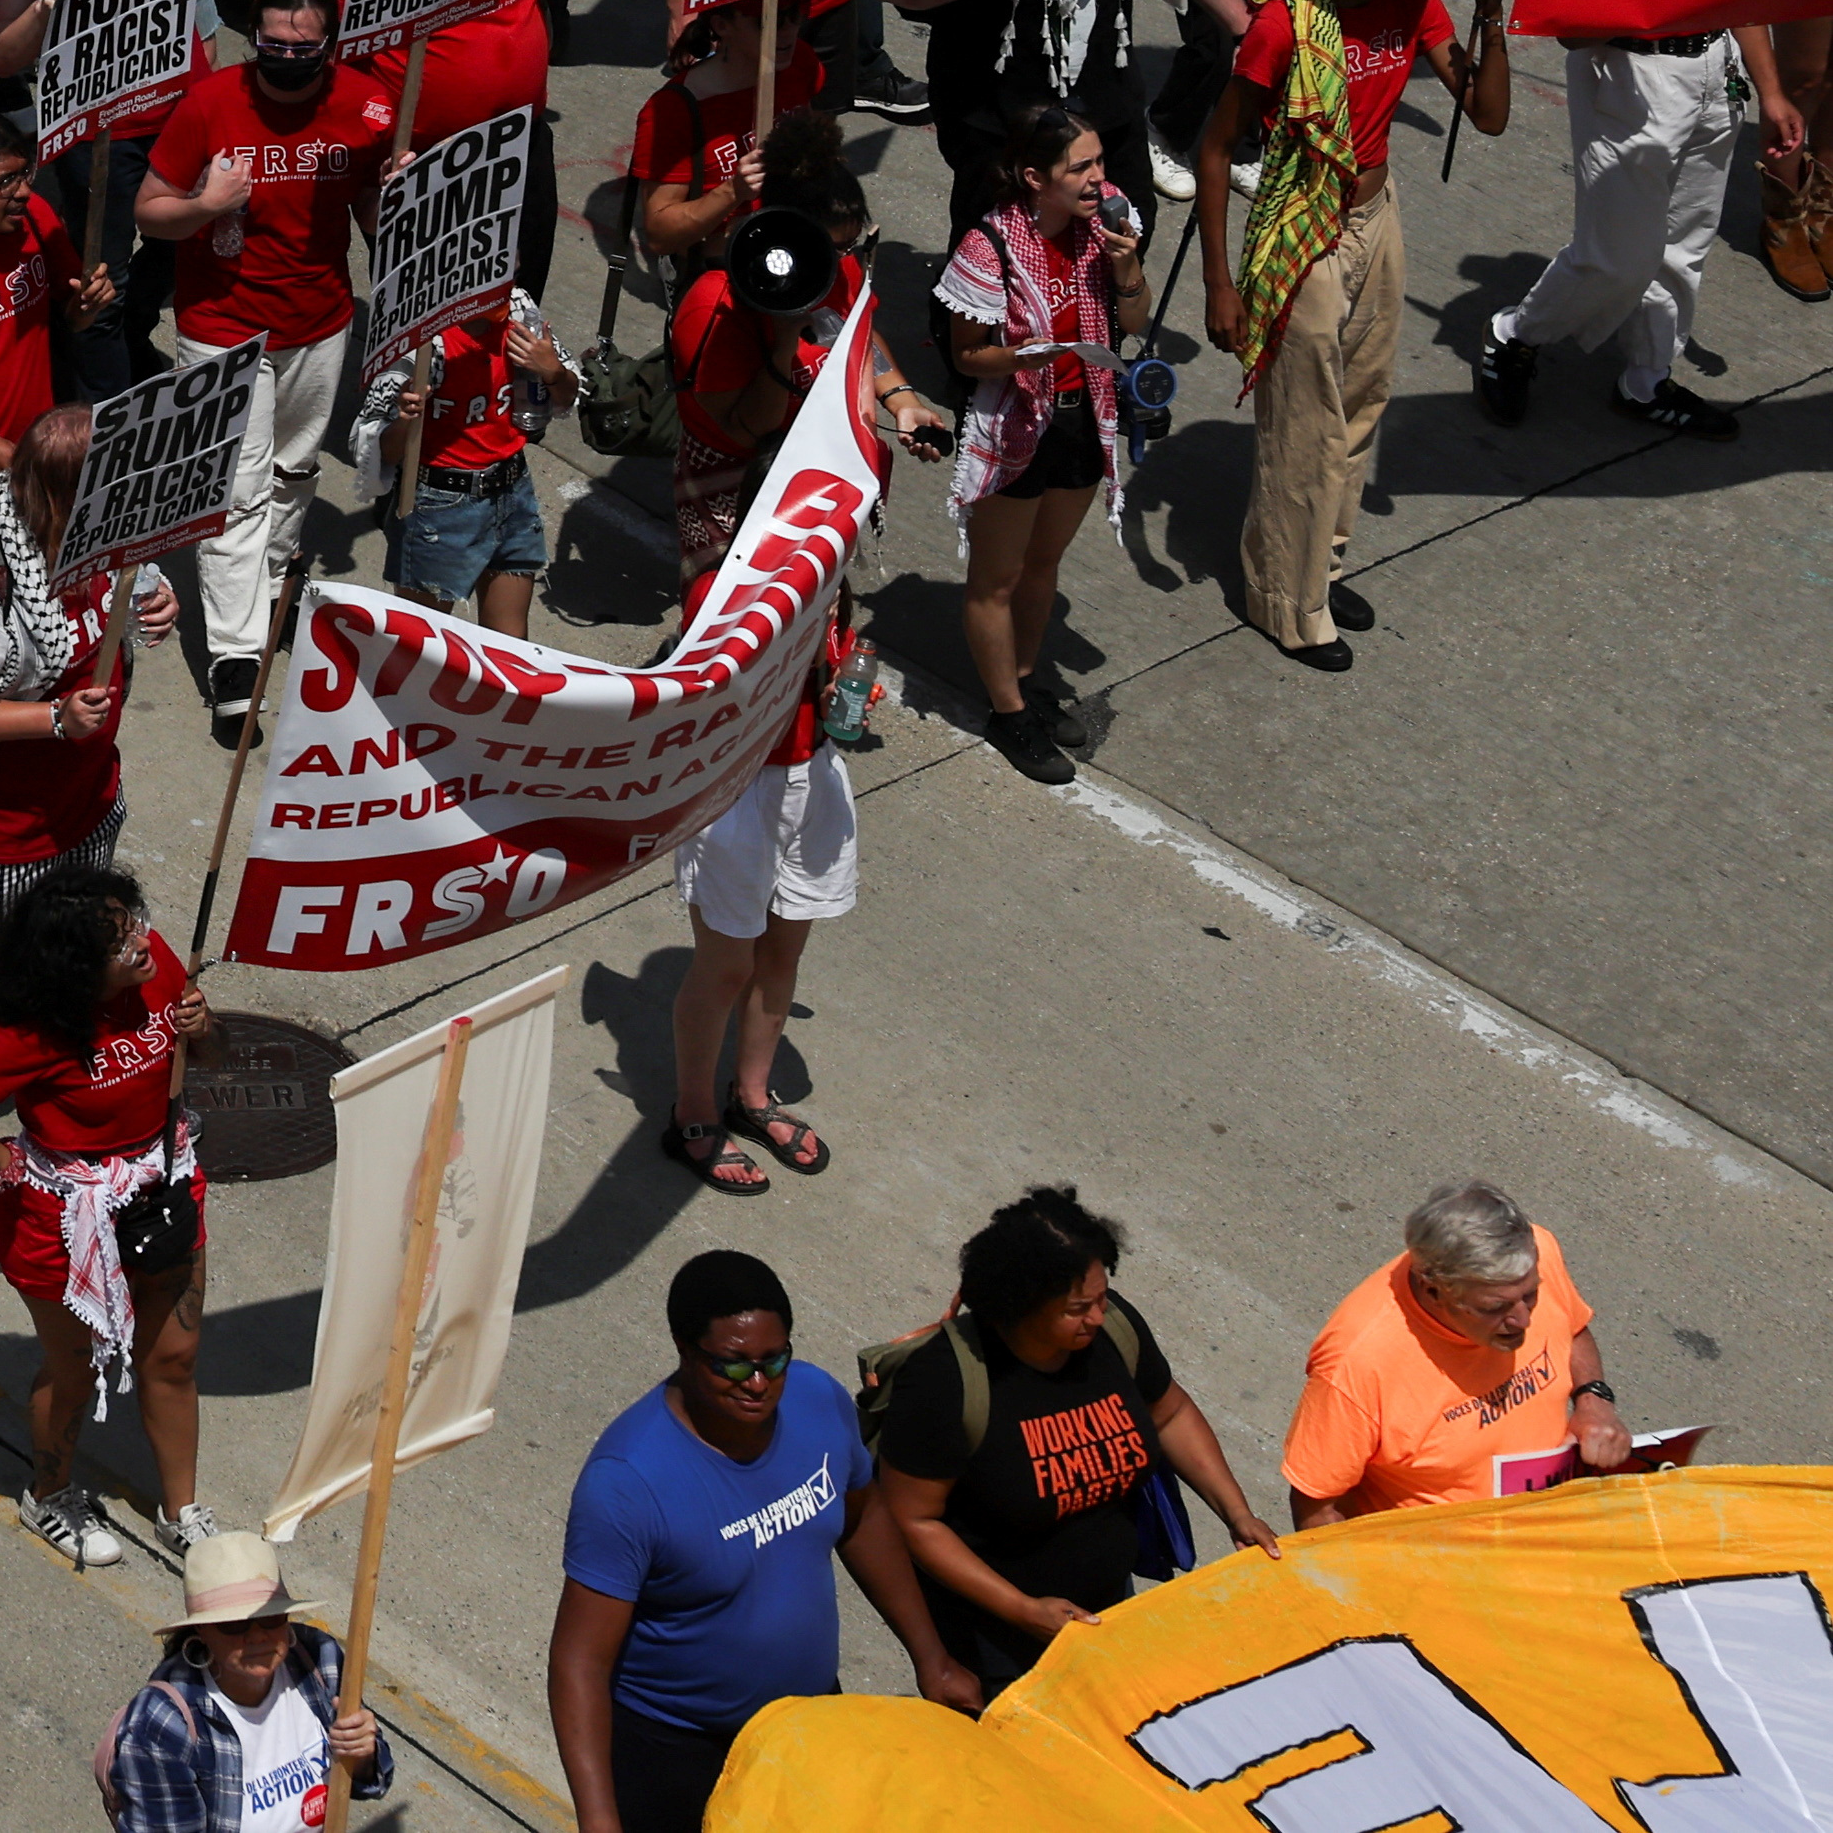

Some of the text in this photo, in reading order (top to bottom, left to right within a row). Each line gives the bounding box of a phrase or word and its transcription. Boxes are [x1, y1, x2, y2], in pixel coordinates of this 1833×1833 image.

[271, 772, 663, 831] REPUBLICAN
[265, 845, 569, 956] FRSO
[1020, 1393, 1135, 1458] WORKING
[1033, 1431, 1148, 1498] FAMILIES
[720, 1483, 812, 1540] VOCES DE LA FRONTERA
[755, 1496, 817, 1549] ACTION
